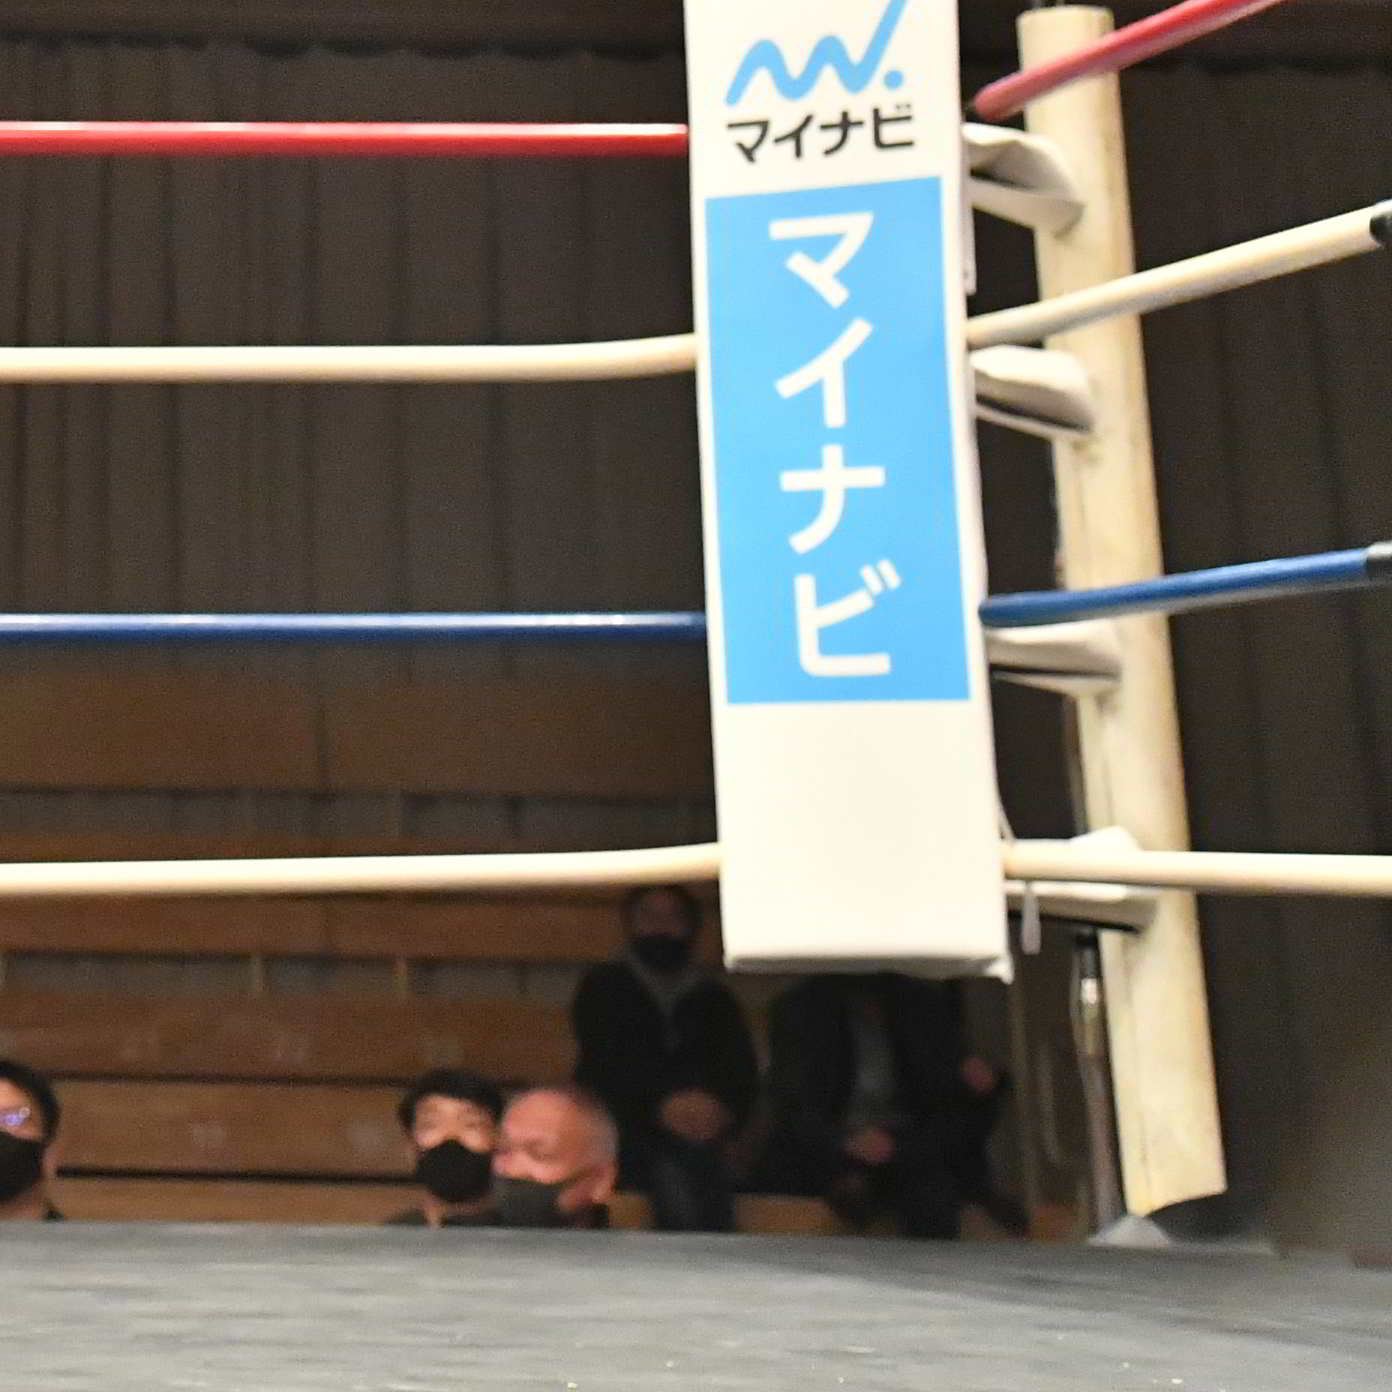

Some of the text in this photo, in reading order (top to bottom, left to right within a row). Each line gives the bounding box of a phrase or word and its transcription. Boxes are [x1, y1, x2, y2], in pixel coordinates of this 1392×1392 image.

[726, 102, 916, 164] マイナビ
[768, 210, 903, 678] マイナビ
